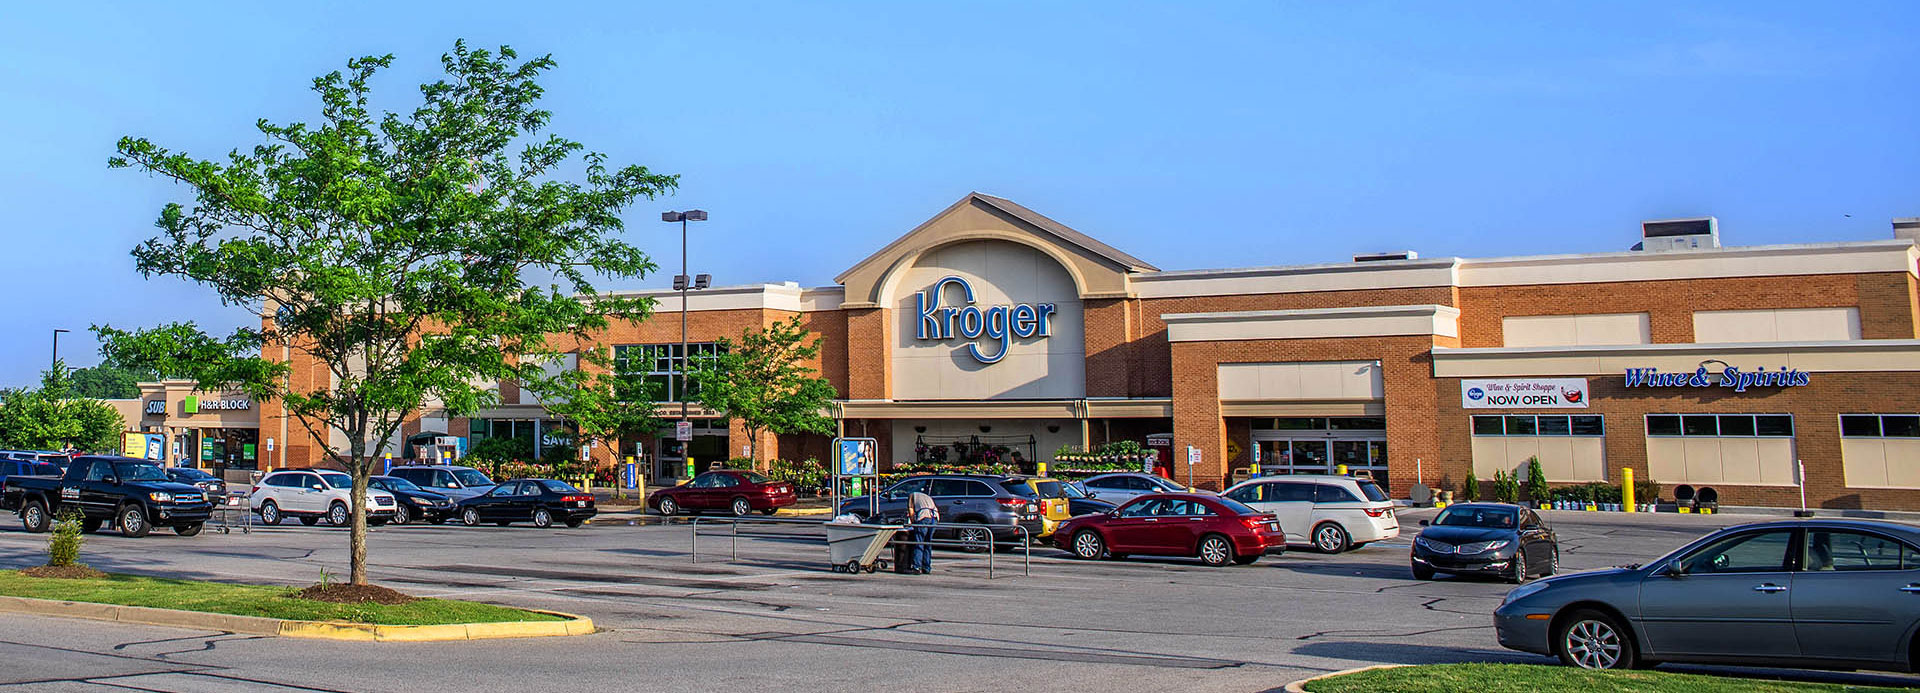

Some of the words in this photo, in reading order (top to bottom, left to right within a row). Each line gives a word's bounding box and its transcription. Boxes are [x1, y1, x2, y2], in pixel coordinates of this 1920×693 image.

[915, 275, 1057, 364] Kroger
[1719, 365, 1810, 393] Spirits
[1486, 382, 1504, 391] Wine
[1504, 383, 1512, 391] &
[1513, 382, 1531, 393] Spirit
[1532, 383, 1556, 393] Shoppe
[201, 400, 219, 410] H&R
[221, 400, 249, 410] BLOCK
[1487, 395, 1520, 405] NOW
[1522, 395, 1558, 405] OPEN
[146, 400, 167, 414] SUB
